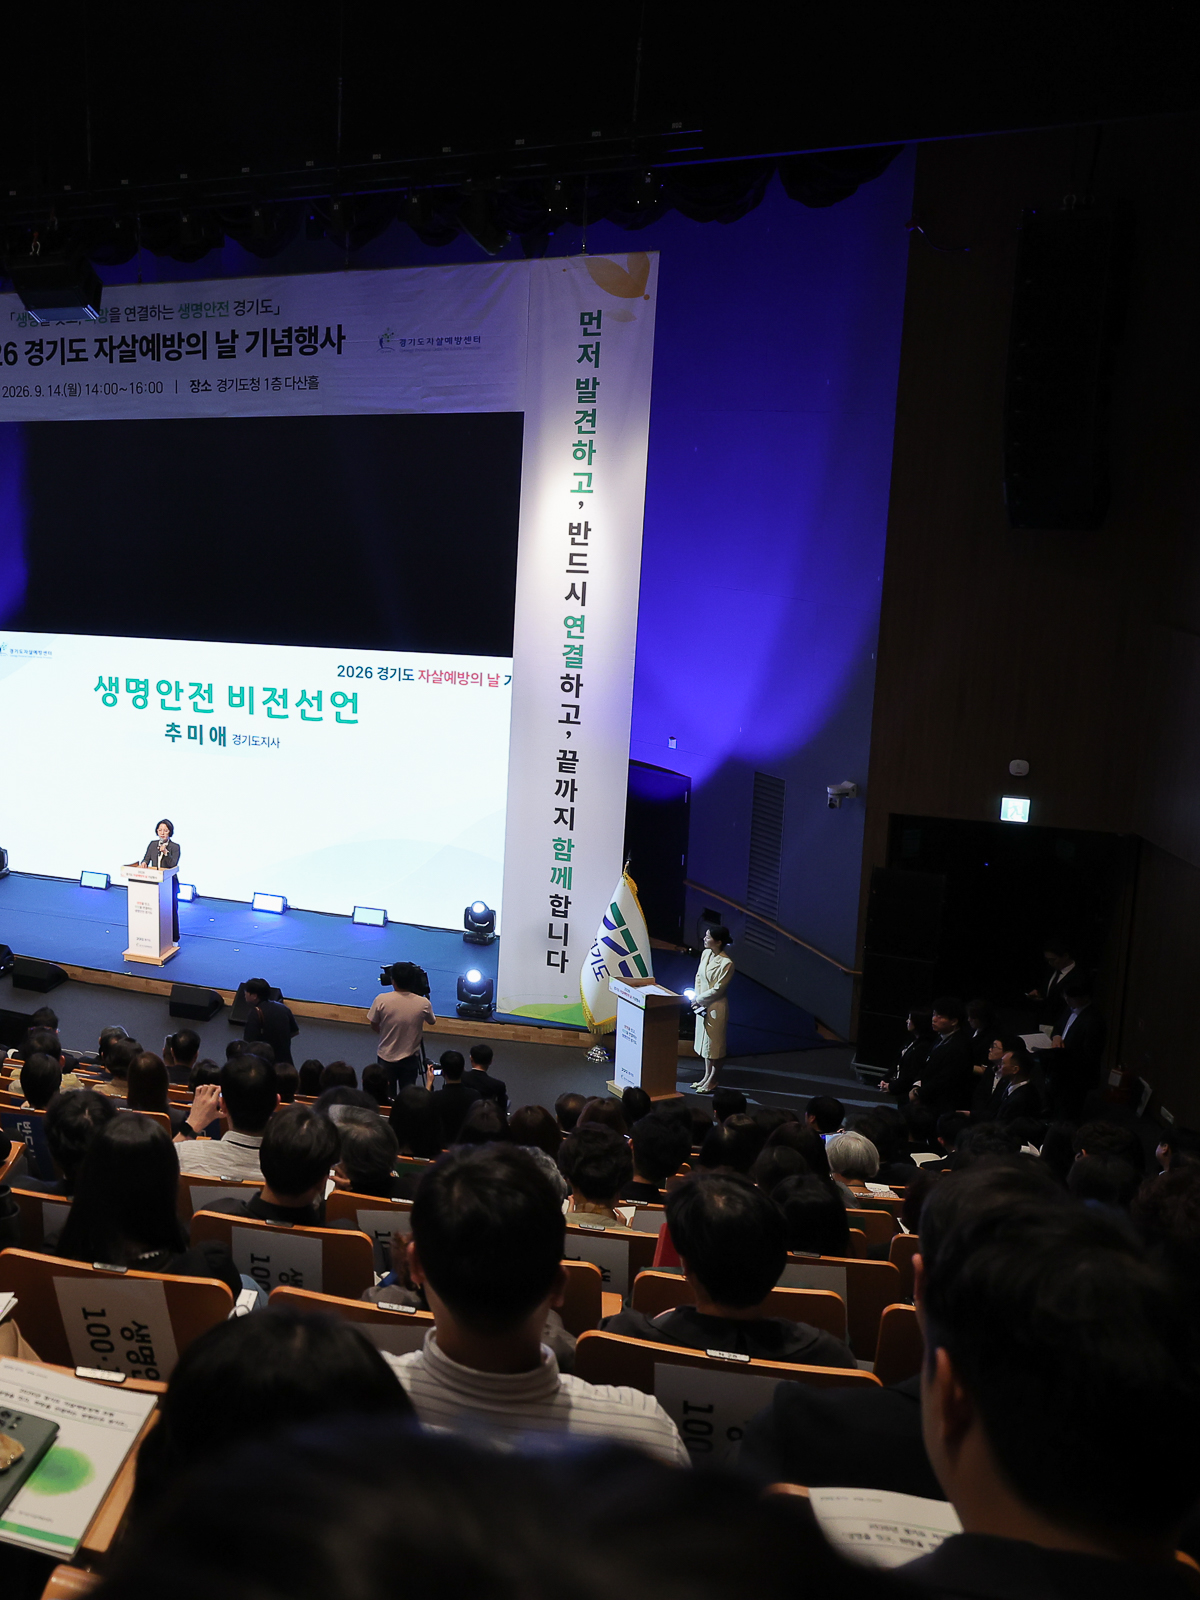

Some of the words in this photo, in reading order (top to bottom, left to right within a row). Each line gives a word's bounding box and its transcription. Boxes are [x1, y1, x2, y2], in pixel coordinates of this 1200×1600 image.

[125, 305, 174, 322] 연결하는
[178, 300, 229, 319] 생명안전
[234, 299, 279, 316] 경기도」
[25, 338, 88, 366] 경기도
[94, 331, 207, 363] 자살예방의
[216, 329, 239, 359] 날
[245, 324, 346, 357] 기념행사
[577, 310, 602, 368] 먼저
[86, 381, 163, 395] 14:00~16:00
[190, 379, 212, 393] 장소
[217, 377, 260, 392] 경기도청
[265, 377, 282, 391] 1층
[285, 375, 319, 390] 다산홀
[571, 377, 599, 509] 발견하고,
[565, 521, 591, 606] 반드시
[94, 676, 214, 713] 생명안전
[227, 686, 359, 725] 비전선언
[338, 665, 373, 679] 2026
[377, 667, 414, 681] 경기도
[418, 670, 482, 686] 자살예방의
[488, 674, 500, 687] 날
[558, 615, 585, 739] 연결하고,
[233, 735, 280, 748] 경기도지사
[554, 750, 579, 831] 끝까지
